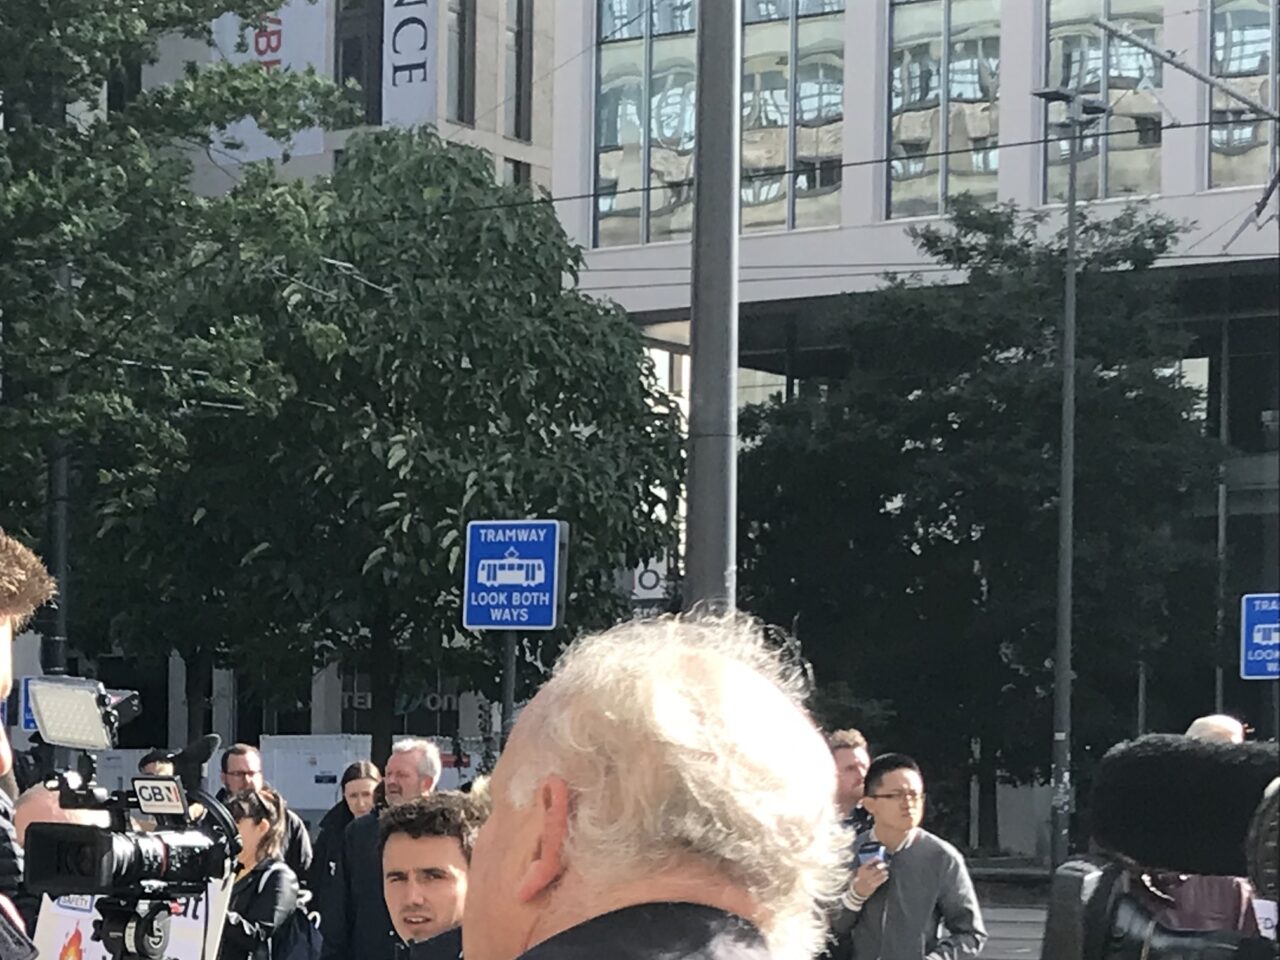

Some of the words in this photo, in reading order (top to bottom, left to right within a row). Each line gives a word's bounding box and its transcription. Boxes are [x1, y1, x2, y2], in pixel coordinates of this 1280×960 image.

[392, 0, 427, 87] CE
[479, 529, 547, 542] TRAMWAY
[471, 592, 508, 605] LOOK
[512, 592, 549, 605] BOTH
[490, 608, 529, 621] WAYS
